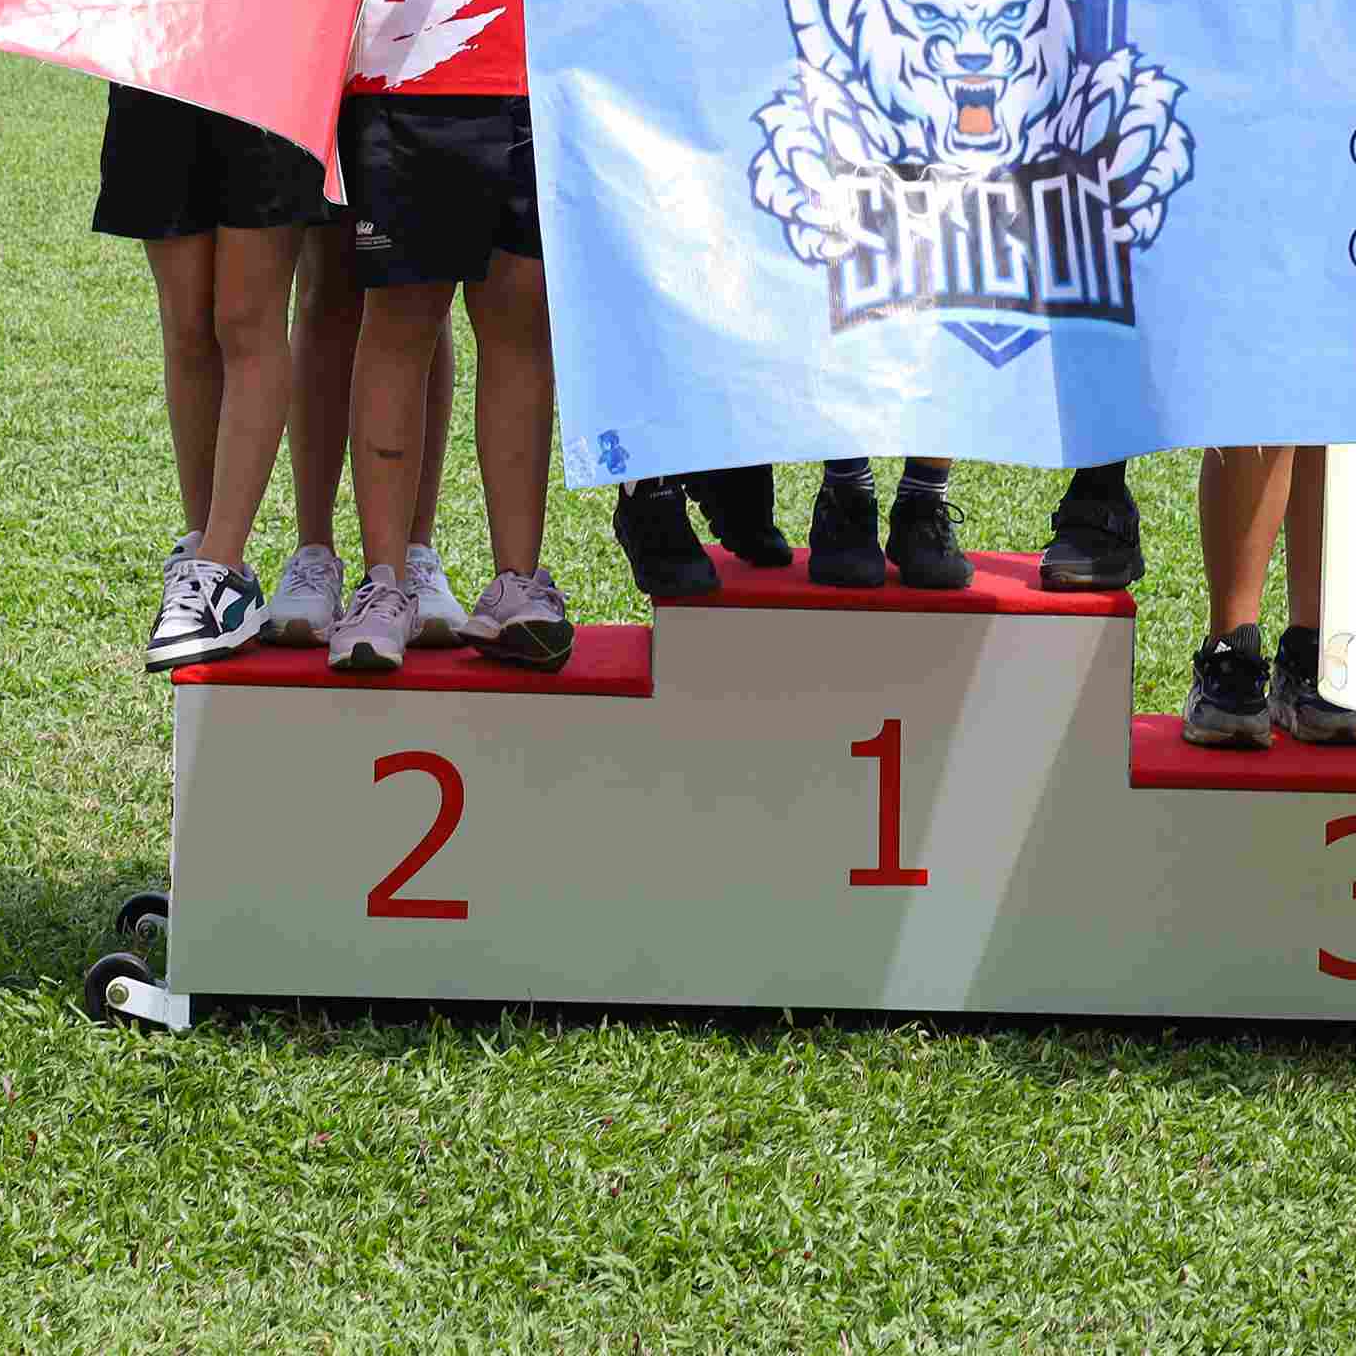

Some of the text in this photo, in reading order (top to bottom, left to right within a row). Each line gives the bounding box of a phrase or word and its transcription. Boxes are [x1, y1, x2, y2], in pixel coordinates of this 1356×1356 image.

[846, 159, 1124, 306] SAIGON
[367, 750, 469, 919] 2
[851, 718, 928, 887] 1
